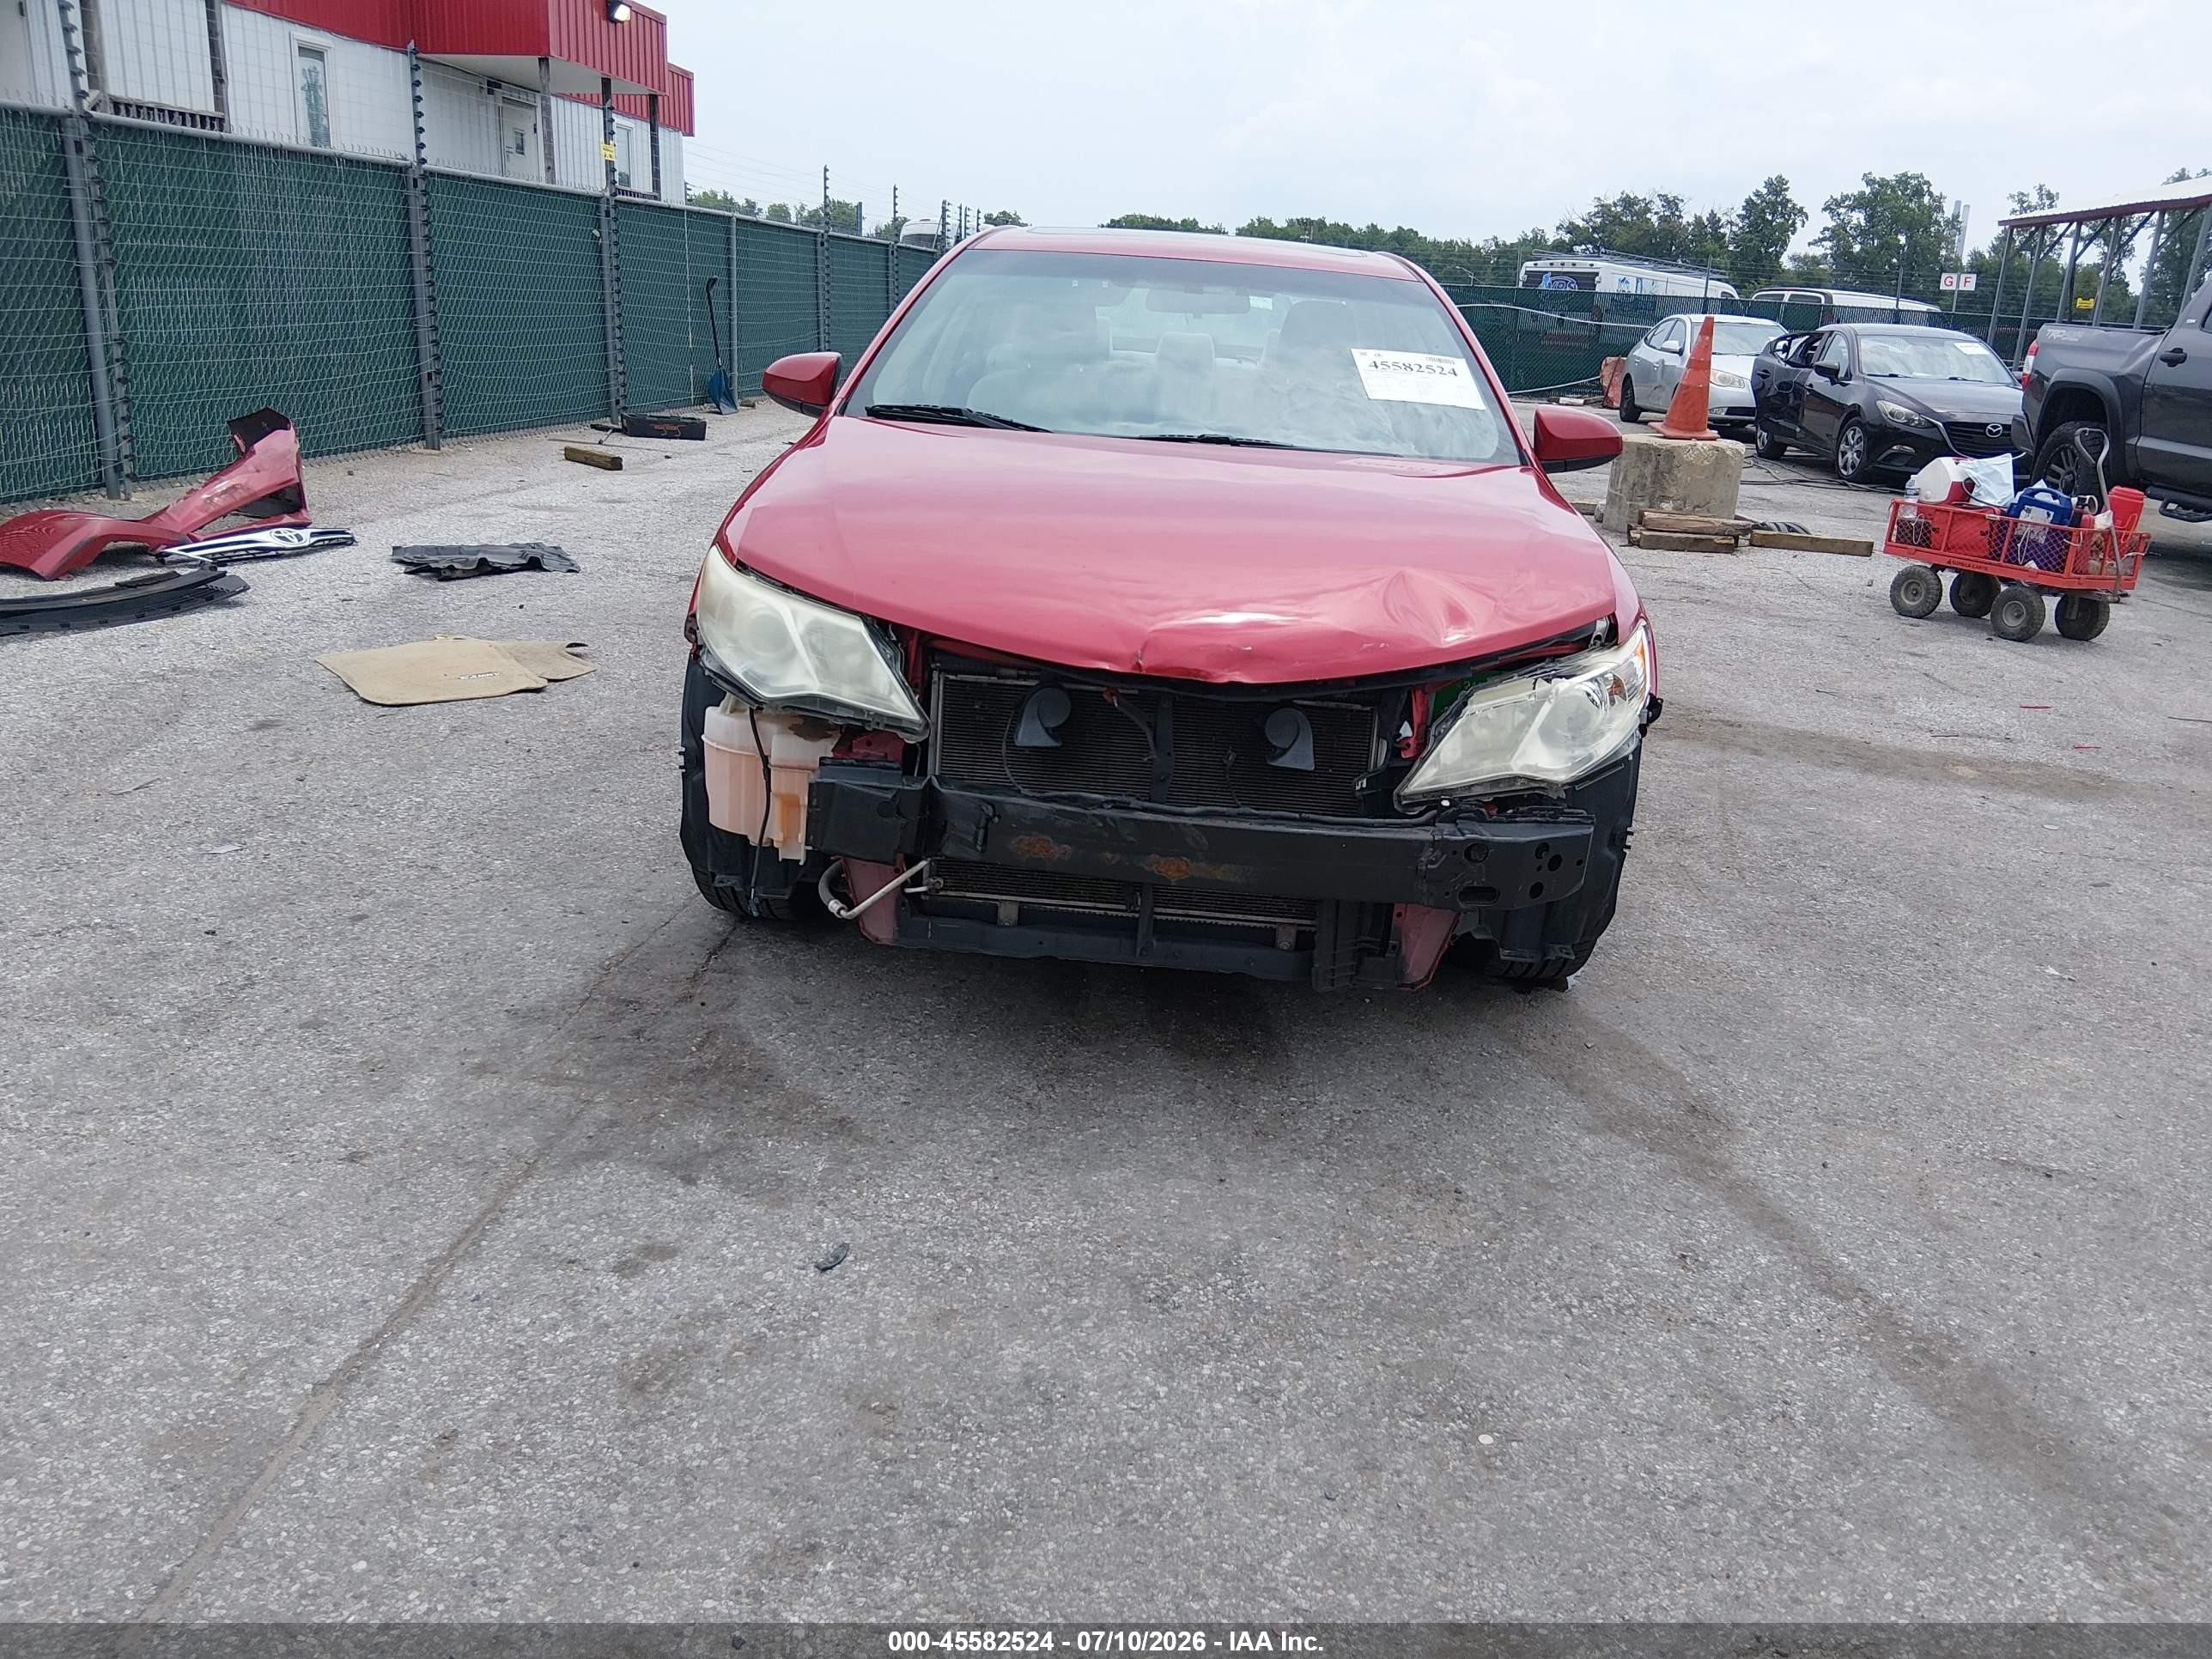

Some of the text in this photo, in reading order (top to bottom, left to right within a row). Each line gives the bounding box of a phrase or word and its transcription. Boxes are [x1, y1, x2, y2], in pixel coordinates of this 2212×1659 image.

[1944, 276, 1954, 287] G
[1964, 276, 1972, 288] F
[1369, 360, 1458, 377] 45582524
